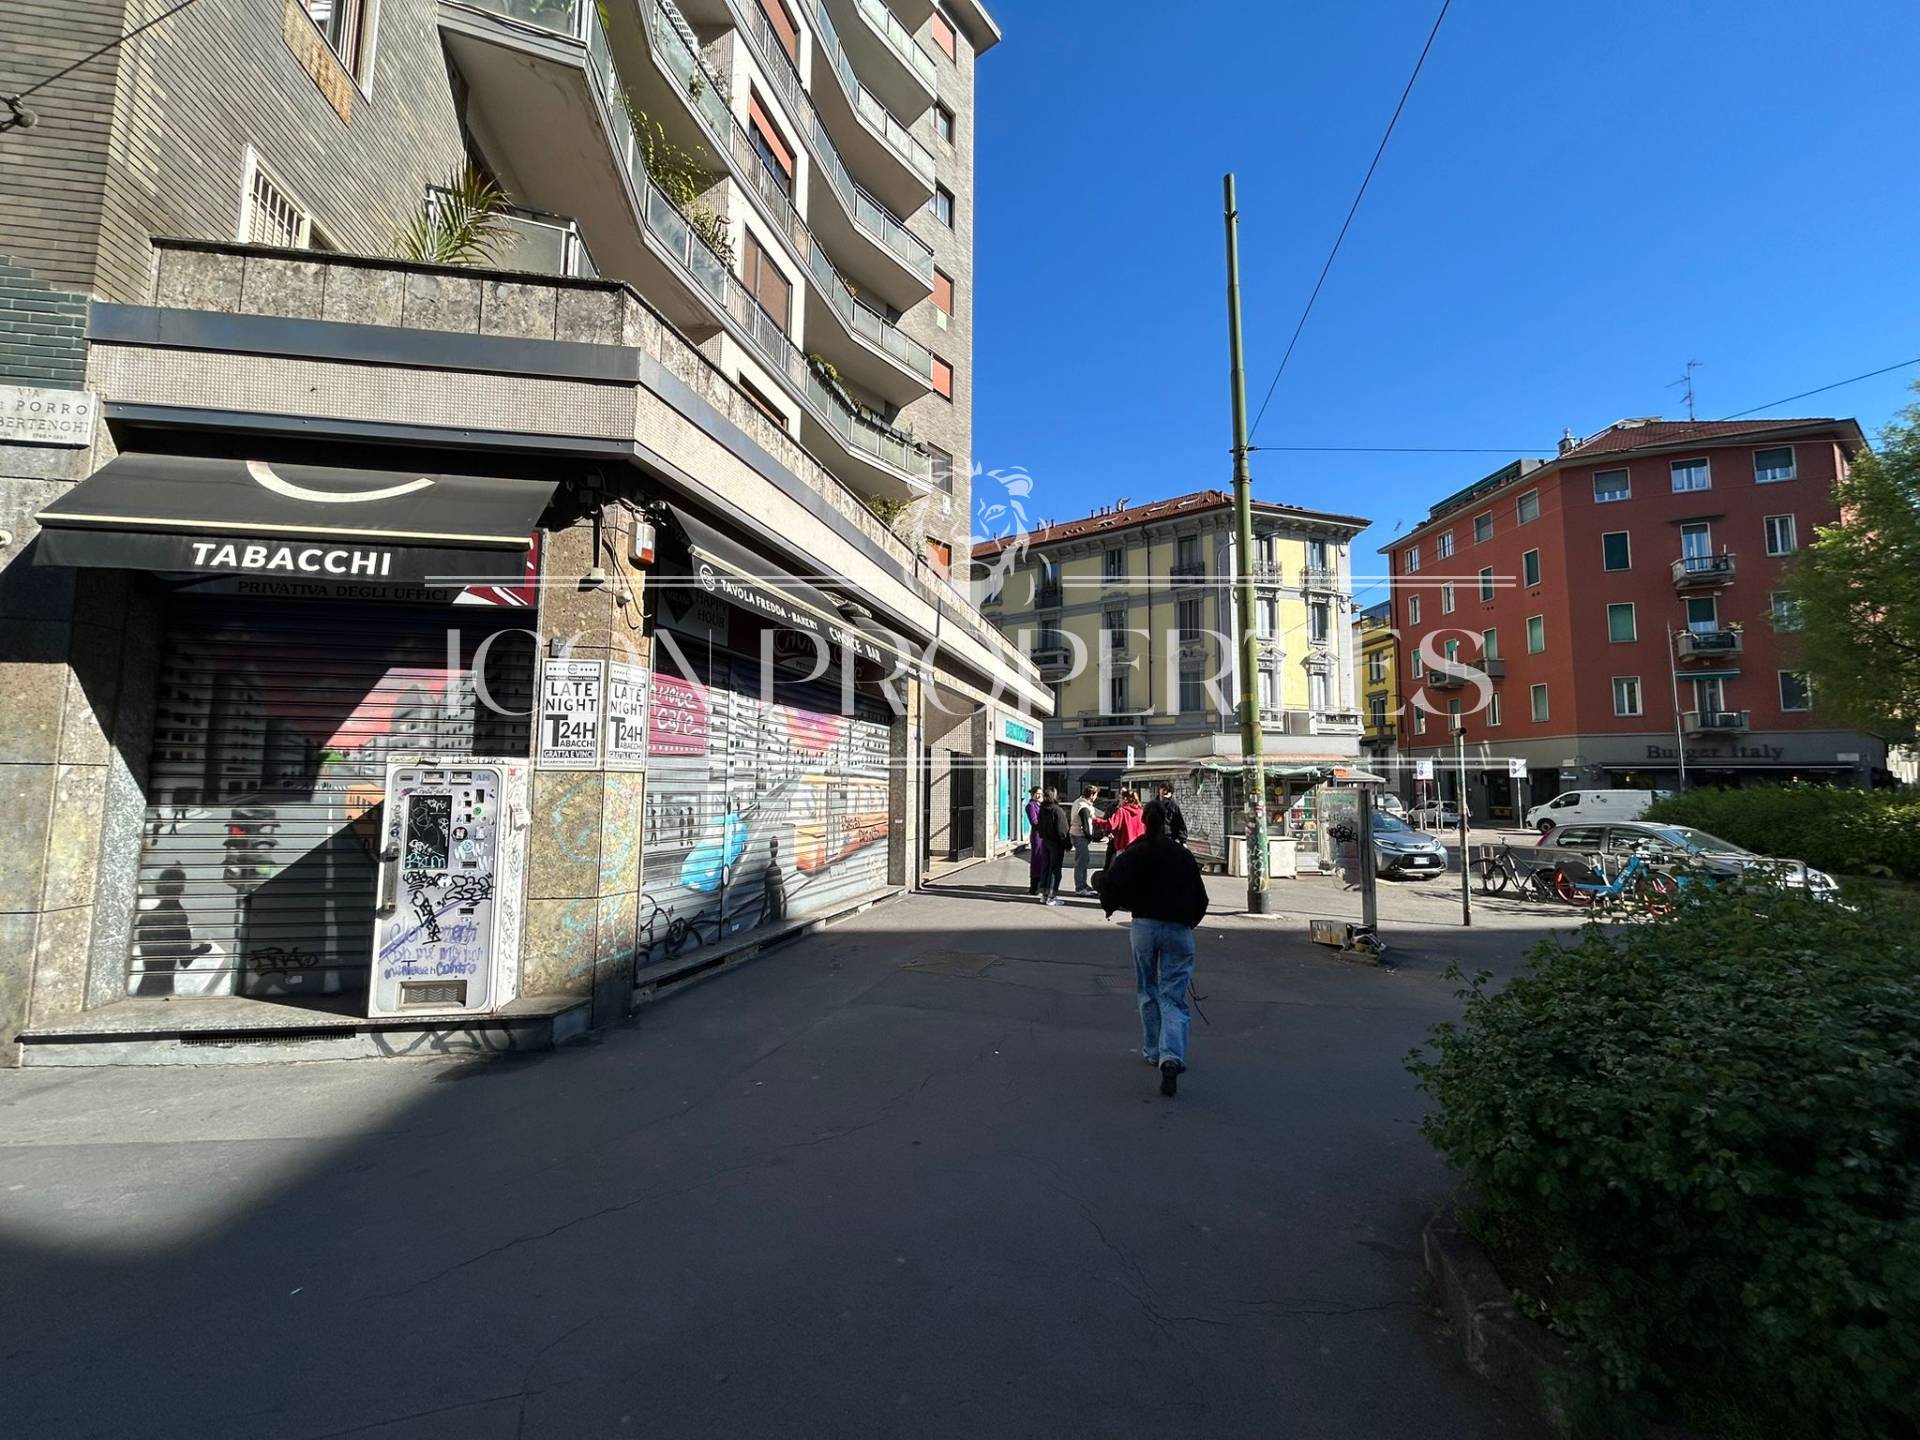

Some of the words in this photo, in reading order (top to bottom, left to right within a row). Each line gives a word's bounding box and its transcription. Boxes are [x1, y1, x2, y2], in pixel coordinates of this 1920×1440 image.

[15, 400, 88, 416] PORRO
[192, 542, 392, 576] TABACCHI
[237, 580, 329, 598] PRIVATIVA
[336, 585, 387, 599] DEGLI
[394, 587, 449, 601] UFFICI
[720, 579, 756, 606] TAVOLA
[756, 595, 788, 620] FREDDA
[697, 609, 726, 630] HOUR
[828, 626, 863, 654] CHOICE
[865, 644, 881, 663] BAR
[551, 681, 593, 697] LATE
[614, 684, 642, 702] LATE
[545, 698, 597, 712] NIGHT
[610, 701, 643, 717] NIGHT
[560, 721, 596, 739] 24H
[621, 724, 643, 742] 24H
[1731, 743, 1785, 761] Italy
